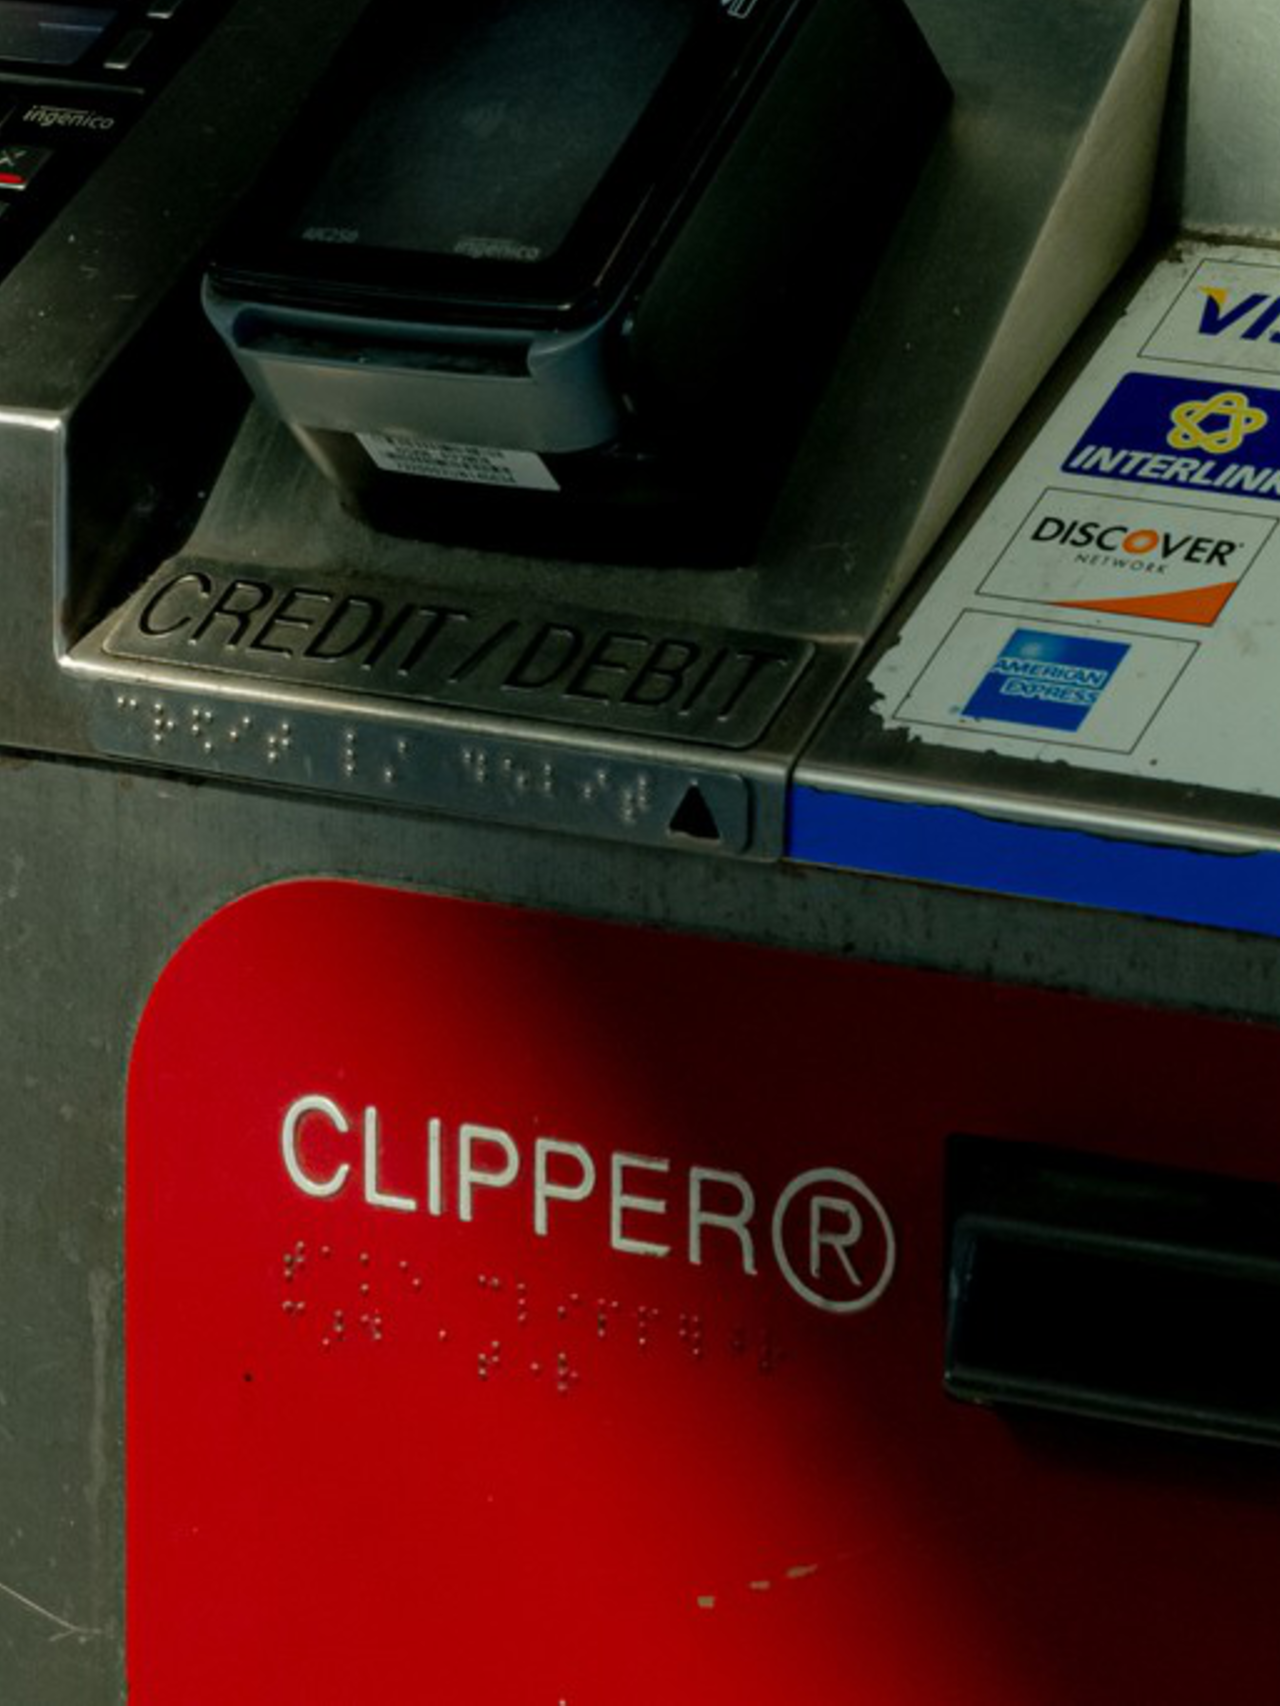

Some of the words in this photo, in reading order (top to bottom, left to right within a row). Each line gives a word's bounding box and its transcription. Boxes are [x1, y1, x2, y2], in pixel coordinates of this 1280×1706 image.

[21, 104, 116, 129] ingenico
[1031, 516, 1238, 567] DISCOVER
[1075, 553, 1169, 575] NETWORK
[993, 657, 1109, 687] AMERICAN
[1002, 677, 1102, 706] EXPRESS
